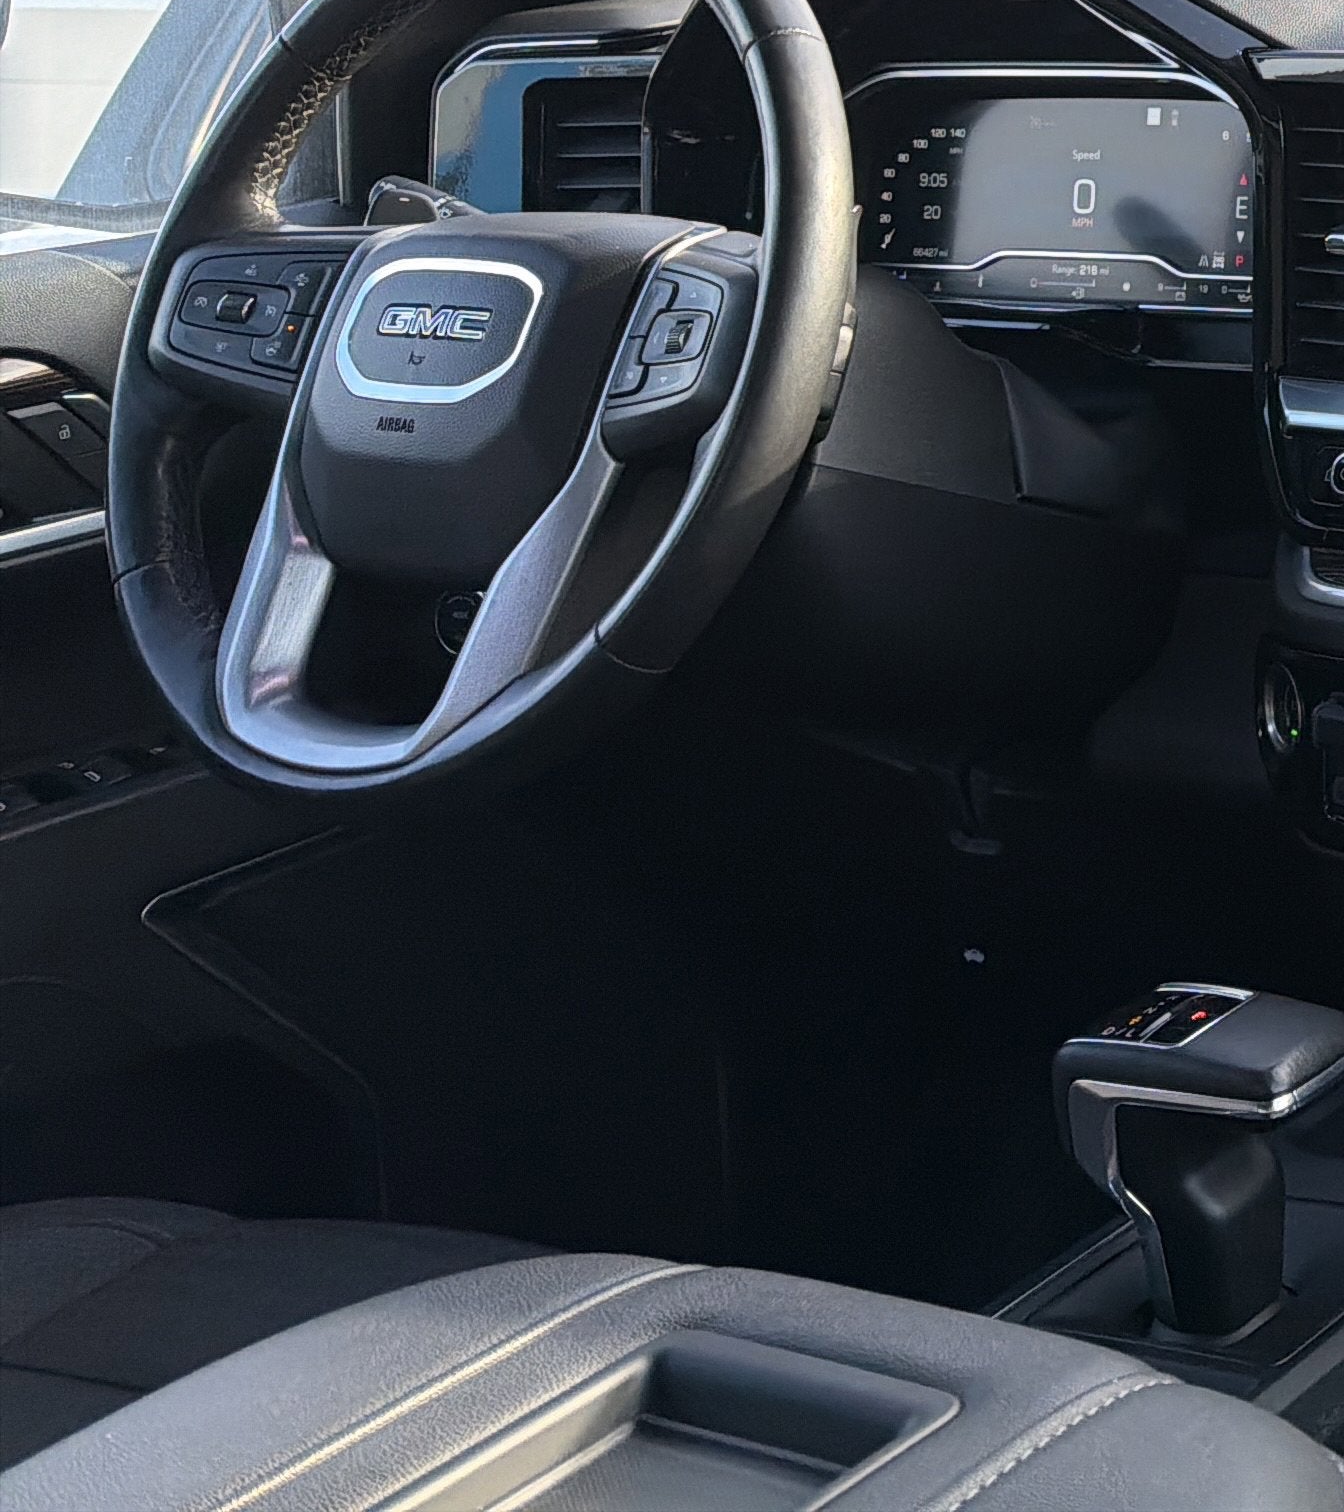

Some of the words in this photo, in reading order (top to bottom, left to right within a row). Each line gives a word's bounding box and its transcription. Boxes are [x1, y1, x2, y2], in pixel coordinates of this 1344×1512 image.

[930, 128, 947, 138] 120
[949, 128, 966, 138] 140
[912, 139, 929, 149] 100
[1072, 149, 1101, 162] Speed
[919, 173, 948, 187] 9:05
[1073, 178, 1096, 214] 0
[1235, 196, 1249, 219] E
[1072, 217, 1094, 228] MPH
[1235, 255, 1245, 268] P
[378, 303, 492, 341] GMC
[375, 415, 415, 434] AIRBAG
